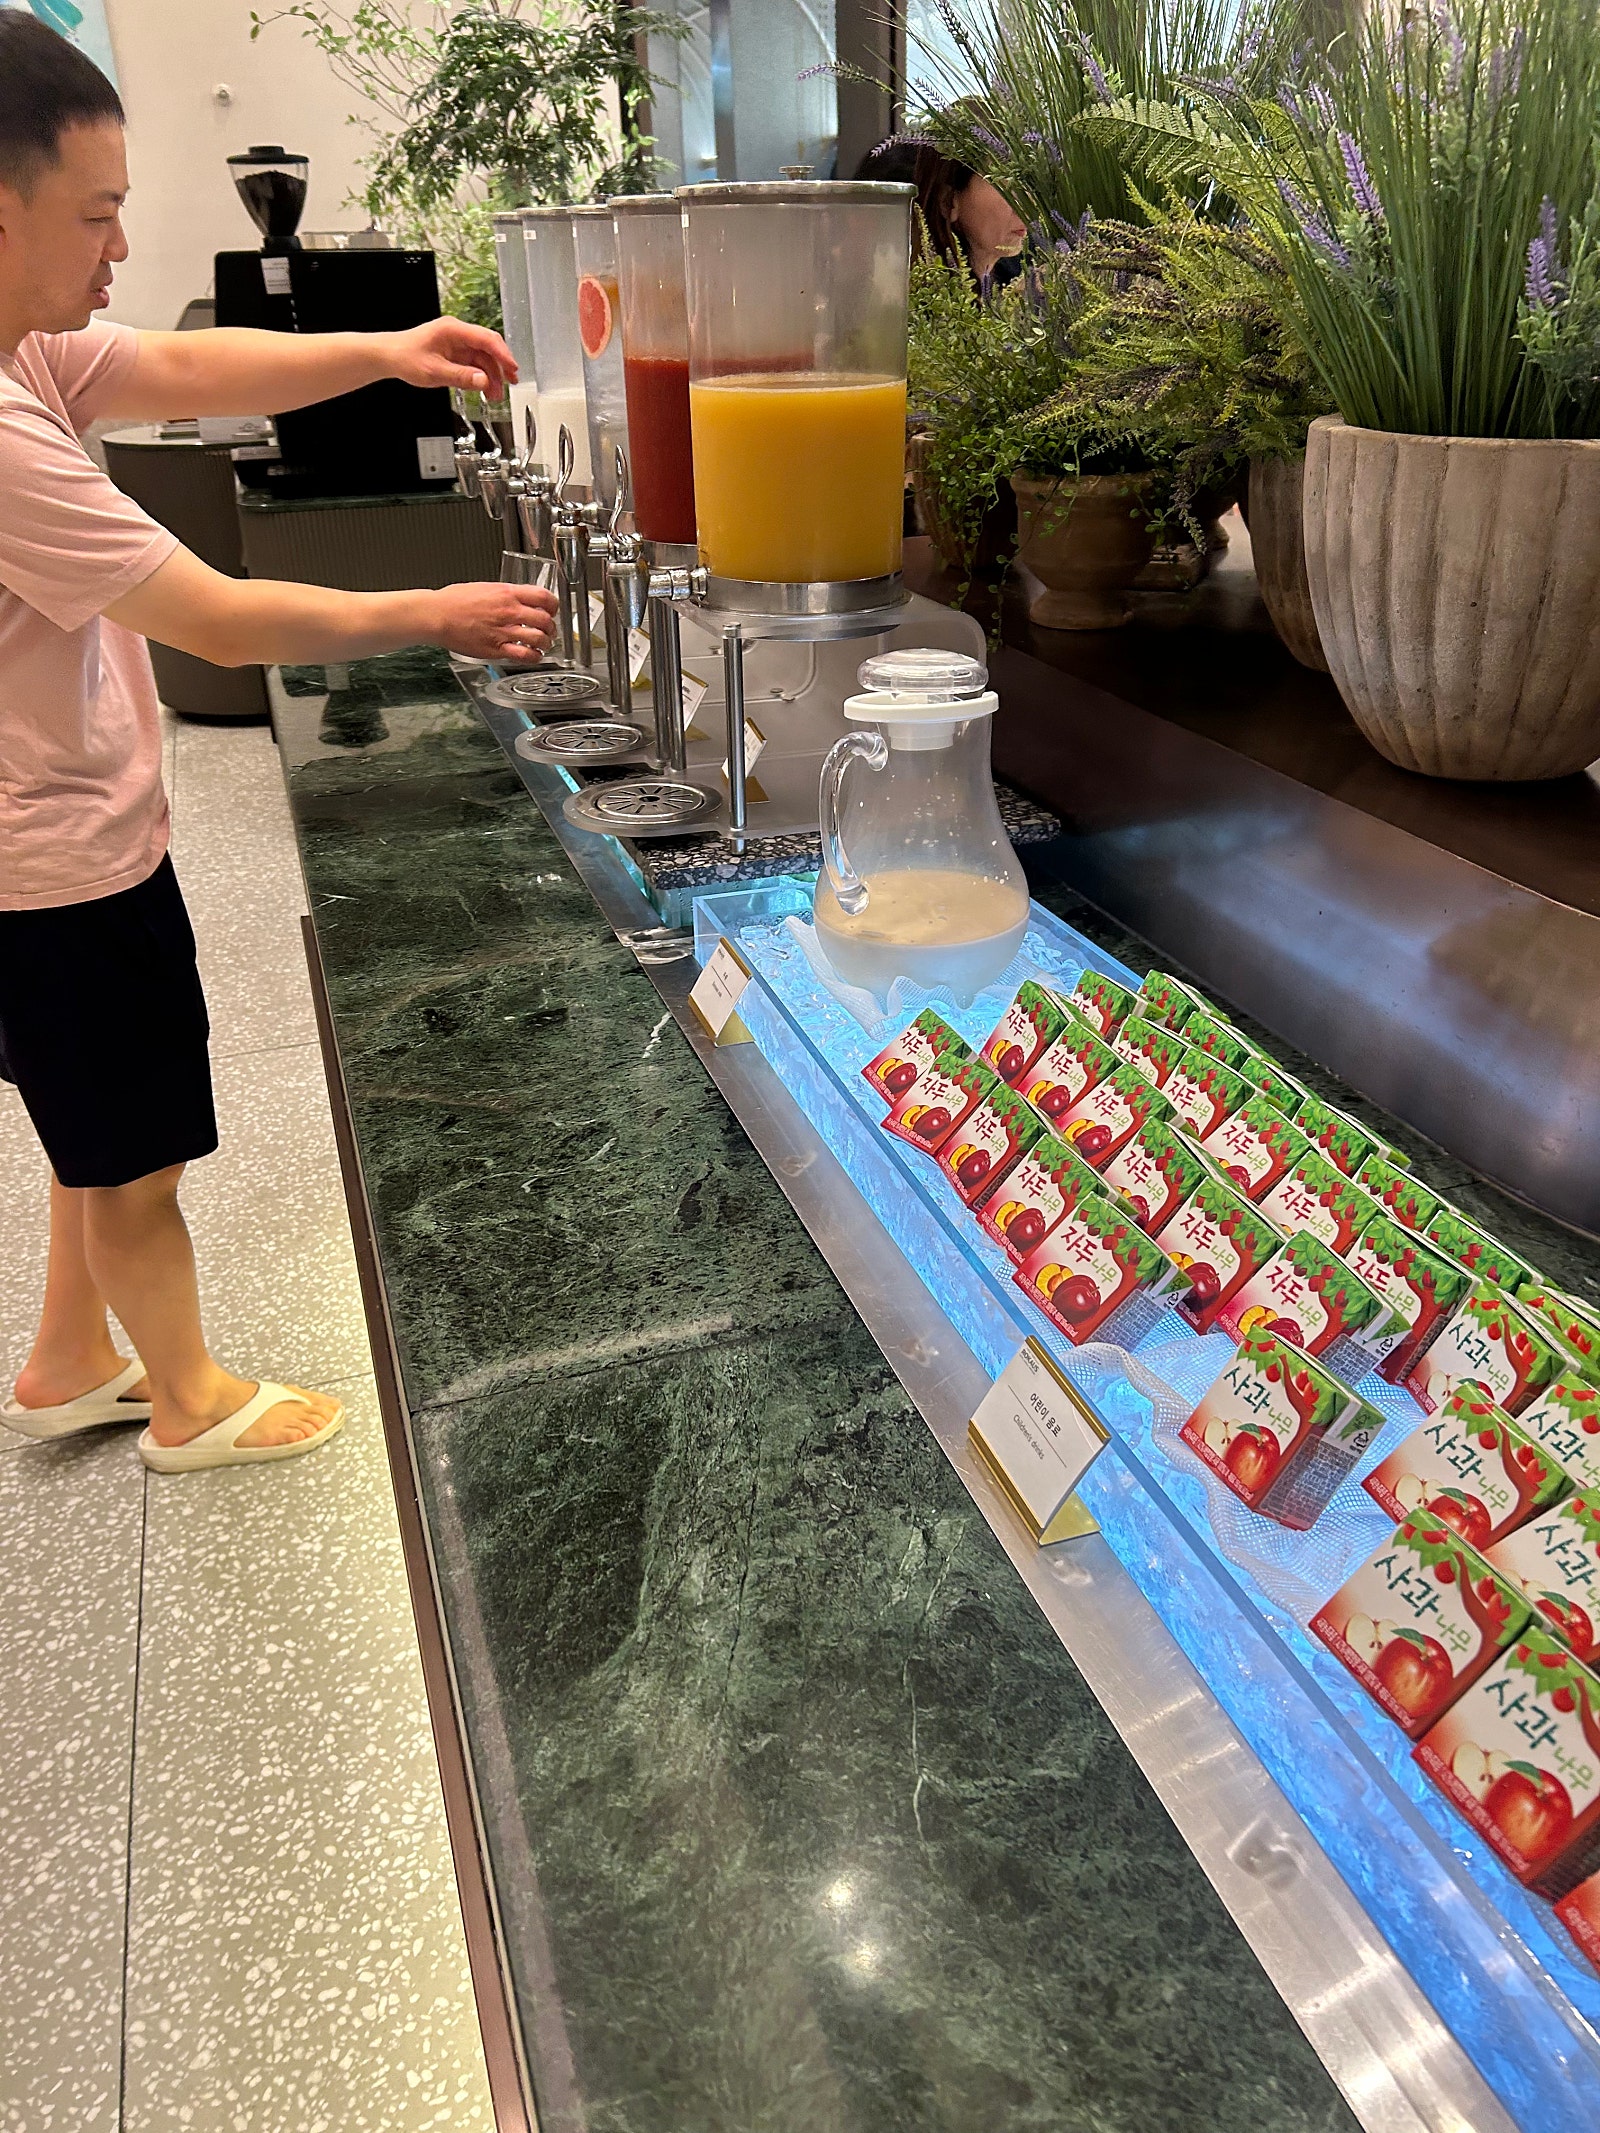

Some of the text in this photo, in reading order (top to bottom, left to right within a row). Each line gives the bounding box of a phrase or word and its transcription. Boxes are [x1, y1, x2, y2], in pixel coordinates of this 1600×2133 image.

[1030, 1393, 1061, 1437] 어린이 음료
[1031, 1441, 1044, 1460] drinks
